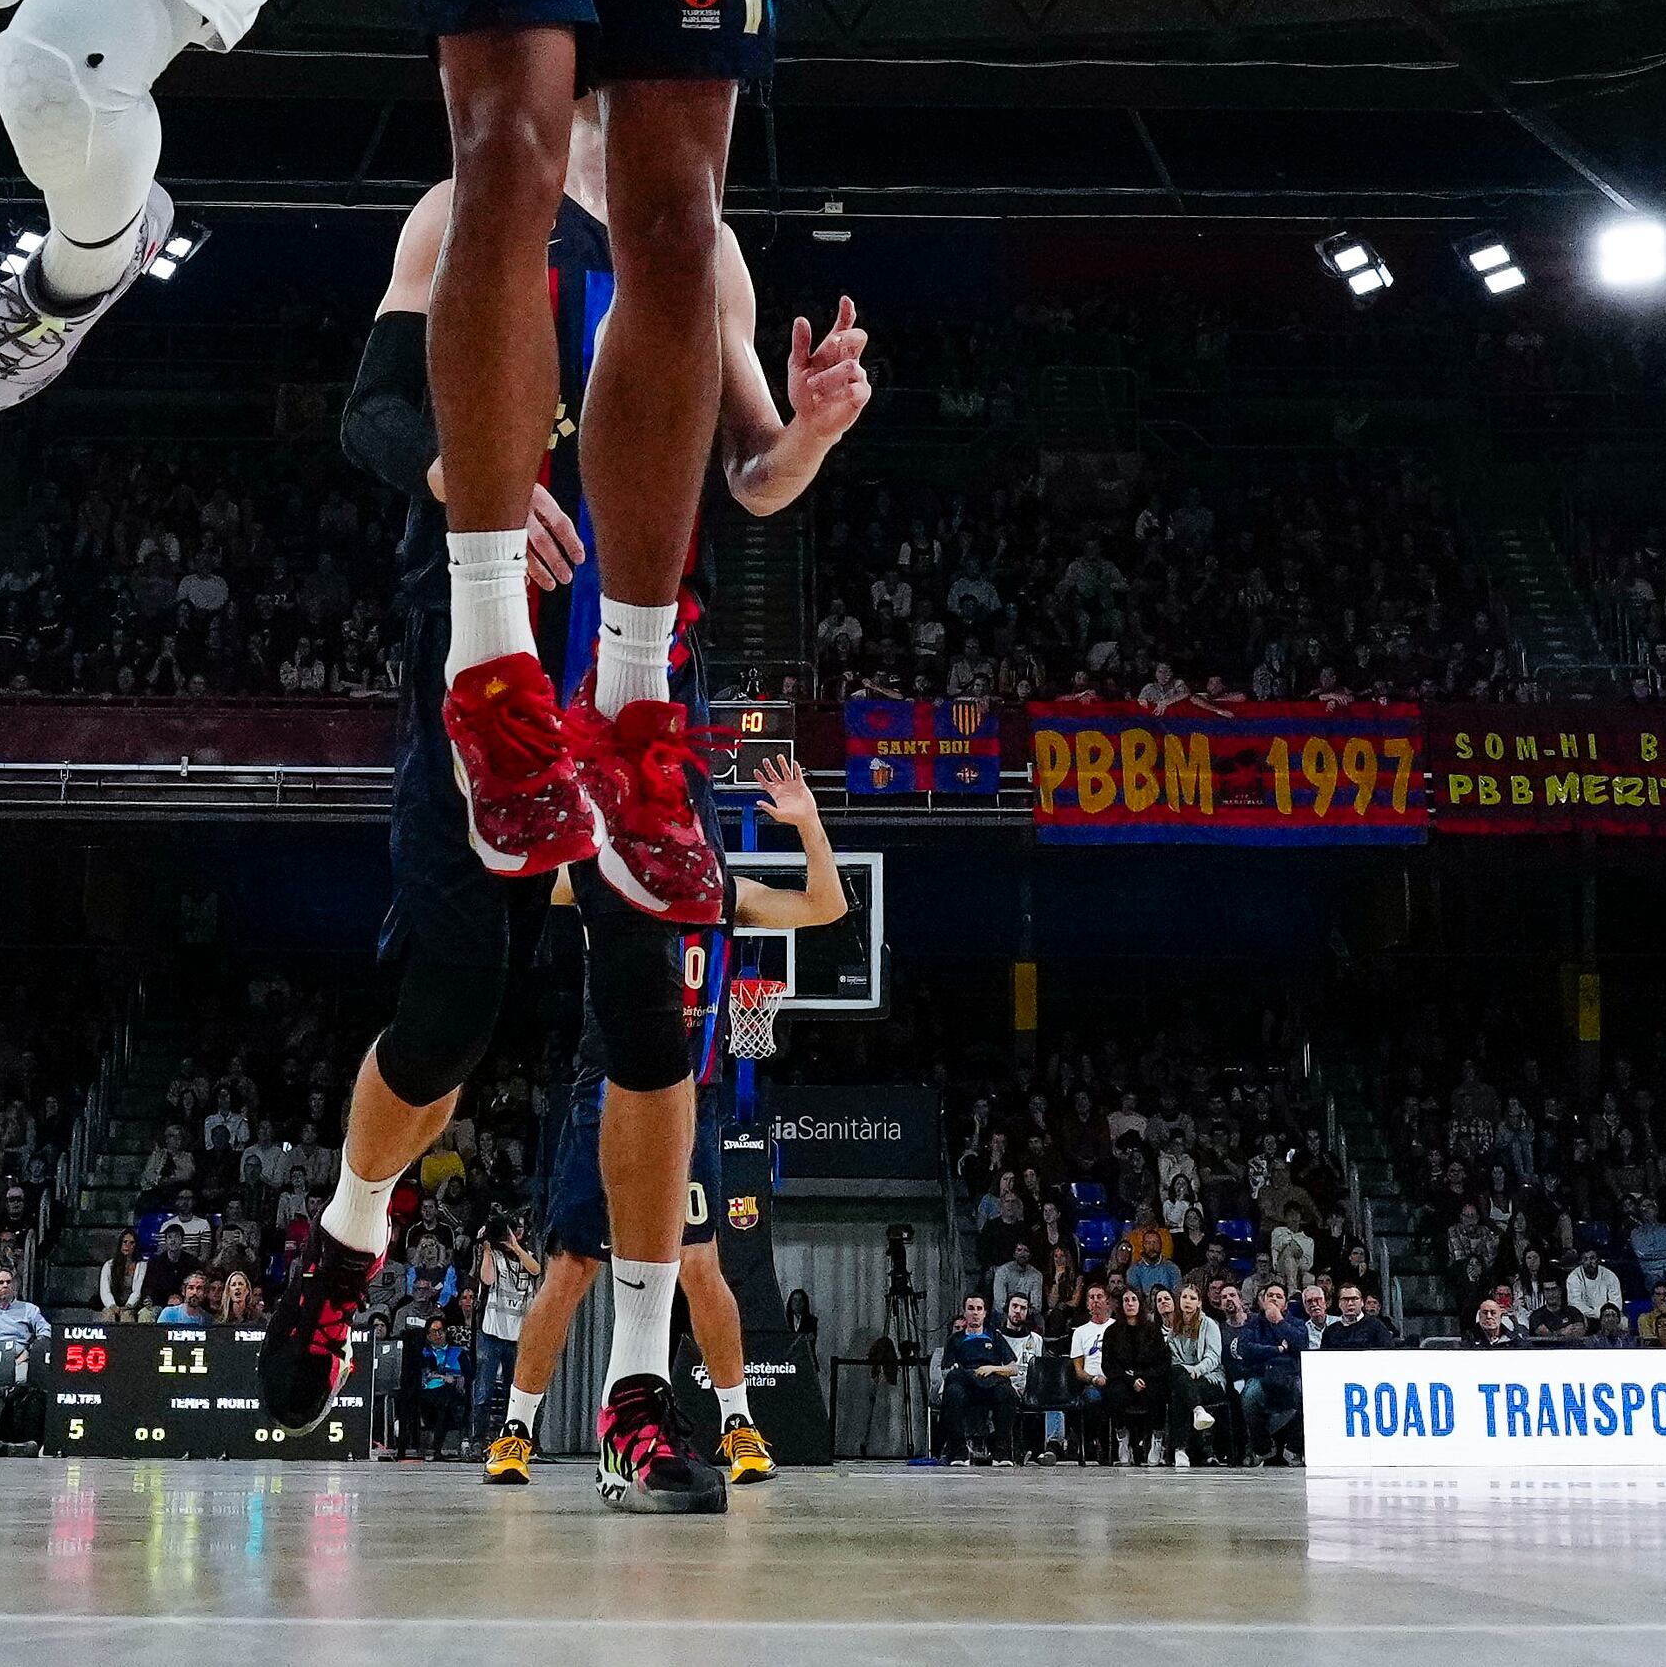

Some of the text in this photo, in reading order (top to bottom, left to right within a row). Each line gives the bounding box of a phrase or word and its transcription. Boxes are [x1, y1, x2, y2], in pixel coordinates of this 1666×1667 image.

[876, 740, 971, 756] SANT BOI
[1455, 732, 1599, 763] SOM-HI
[1034, 727, 1415, 818] PBBM 1997
[1447, 773, 1534, 806] PBB
[723, 1140, 765, 1152] SPALDING
[63, 1326, 108, 1342] LOCAL
[167, 1329, 207, 1342] TEMPS
[63, 1344, 108, 1374] 50
[158, 1346, 209, 1375] 1.1
[743, 1361, 796, 1374] sistència
[57, 1392, 103, 1405] FALTES
[170, 1397, 261, 1410] TEMPS MORTS
[1343, 1382, 1456, 1438] ROAD
[68, 1417, 86, 1440] 5
[327, 1420, 345, 1443] 5
